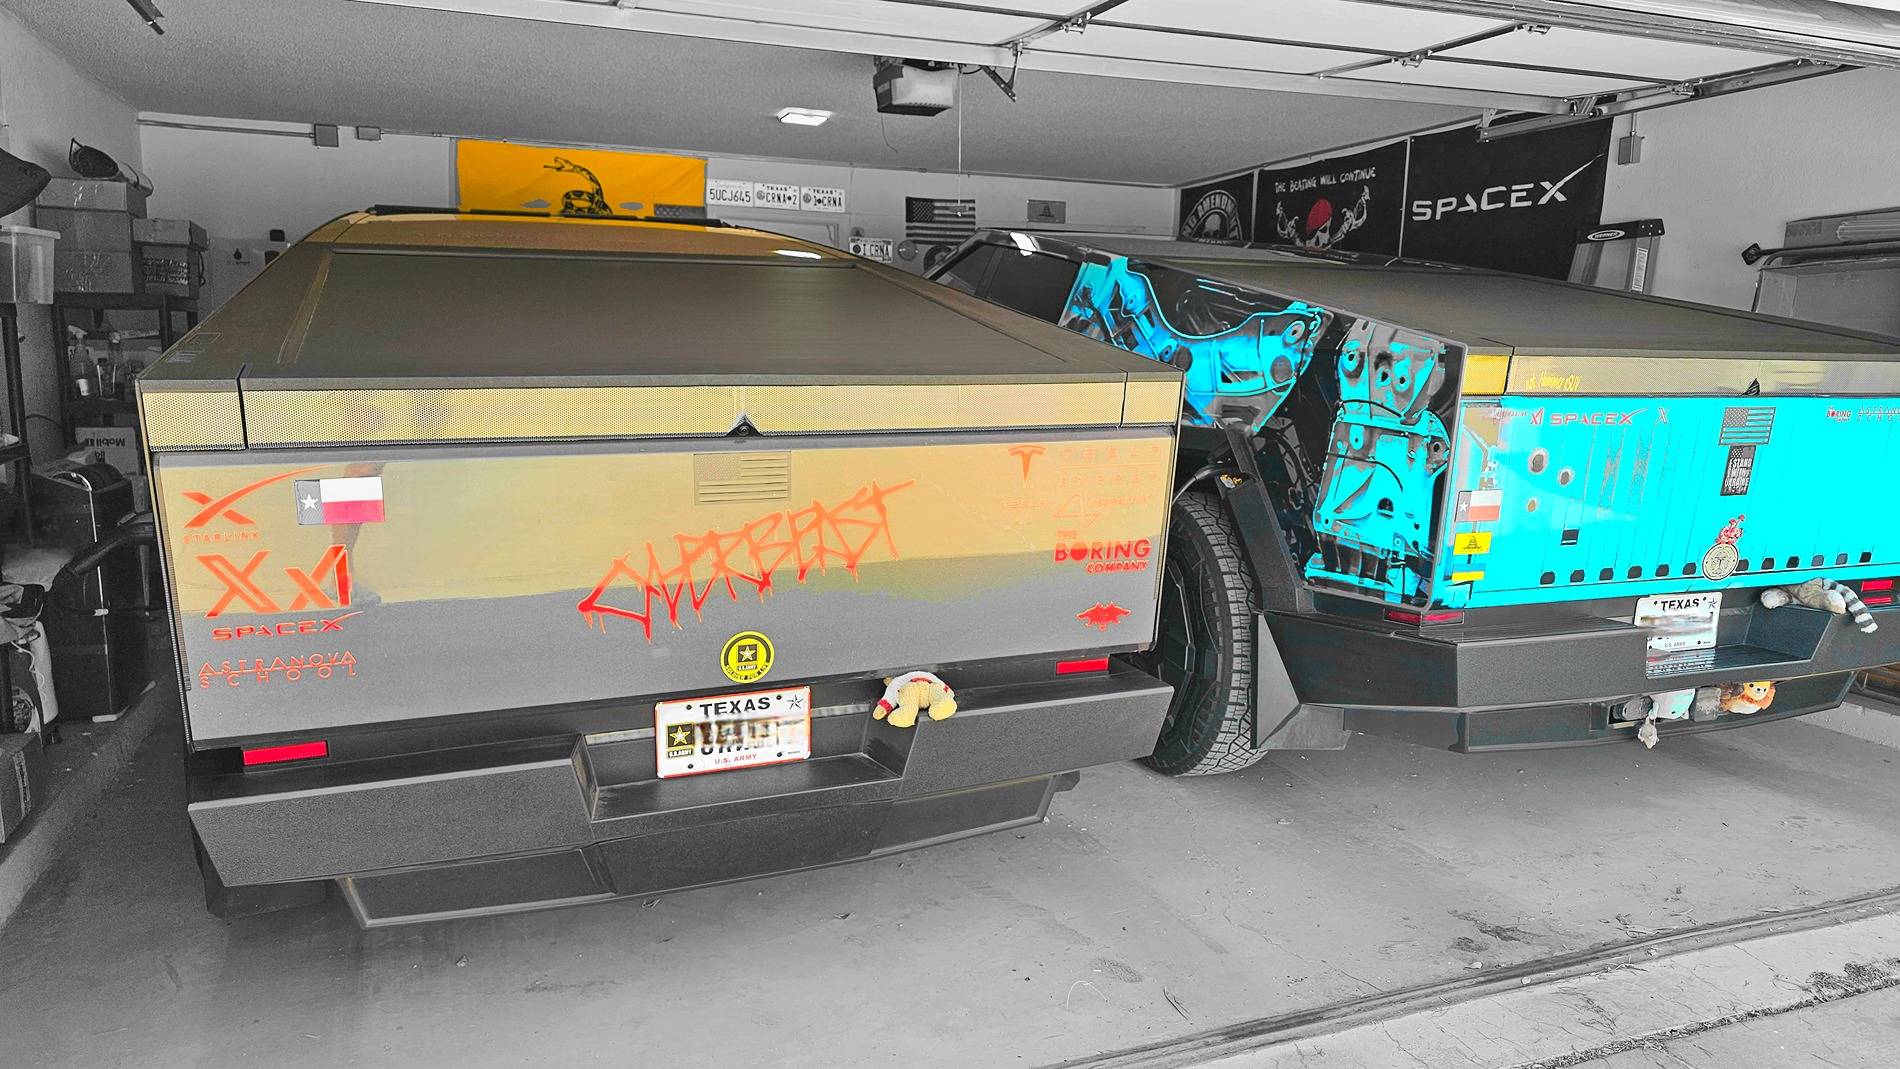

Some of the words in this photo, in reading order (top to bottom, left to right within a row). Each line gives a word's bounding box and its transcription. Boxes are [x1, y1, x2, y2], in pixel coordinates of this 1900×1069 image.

[1274, 182, 1287, 193] THE
[1290, 177, 1318, 193] BEATING
[1320, 175, 1337, 185] WILL
[1340, 167, 1377, 183] CONTINUE
[1412, 153, 1606, 221] SPACEX
[709, 188, 751, 203] 5UCJ645
[1550, 408, 1649, 426] SPACEX
[183, 531, 261, 545] STARLINK
[1054, 538, 1152, 563] BORING
[1085, 560, 1150, 574] COMPANY
[1660, 598, 1700, 612] TEXAS
[212, 611, 364, 641] SPACEX
[199, 651, 357, 676] ASTRANOVA
[200, 664, 357, 690] SCHOOL
[699, 696, 771, 718] TEXAS
[733, 753, 758, 763] ARMY
